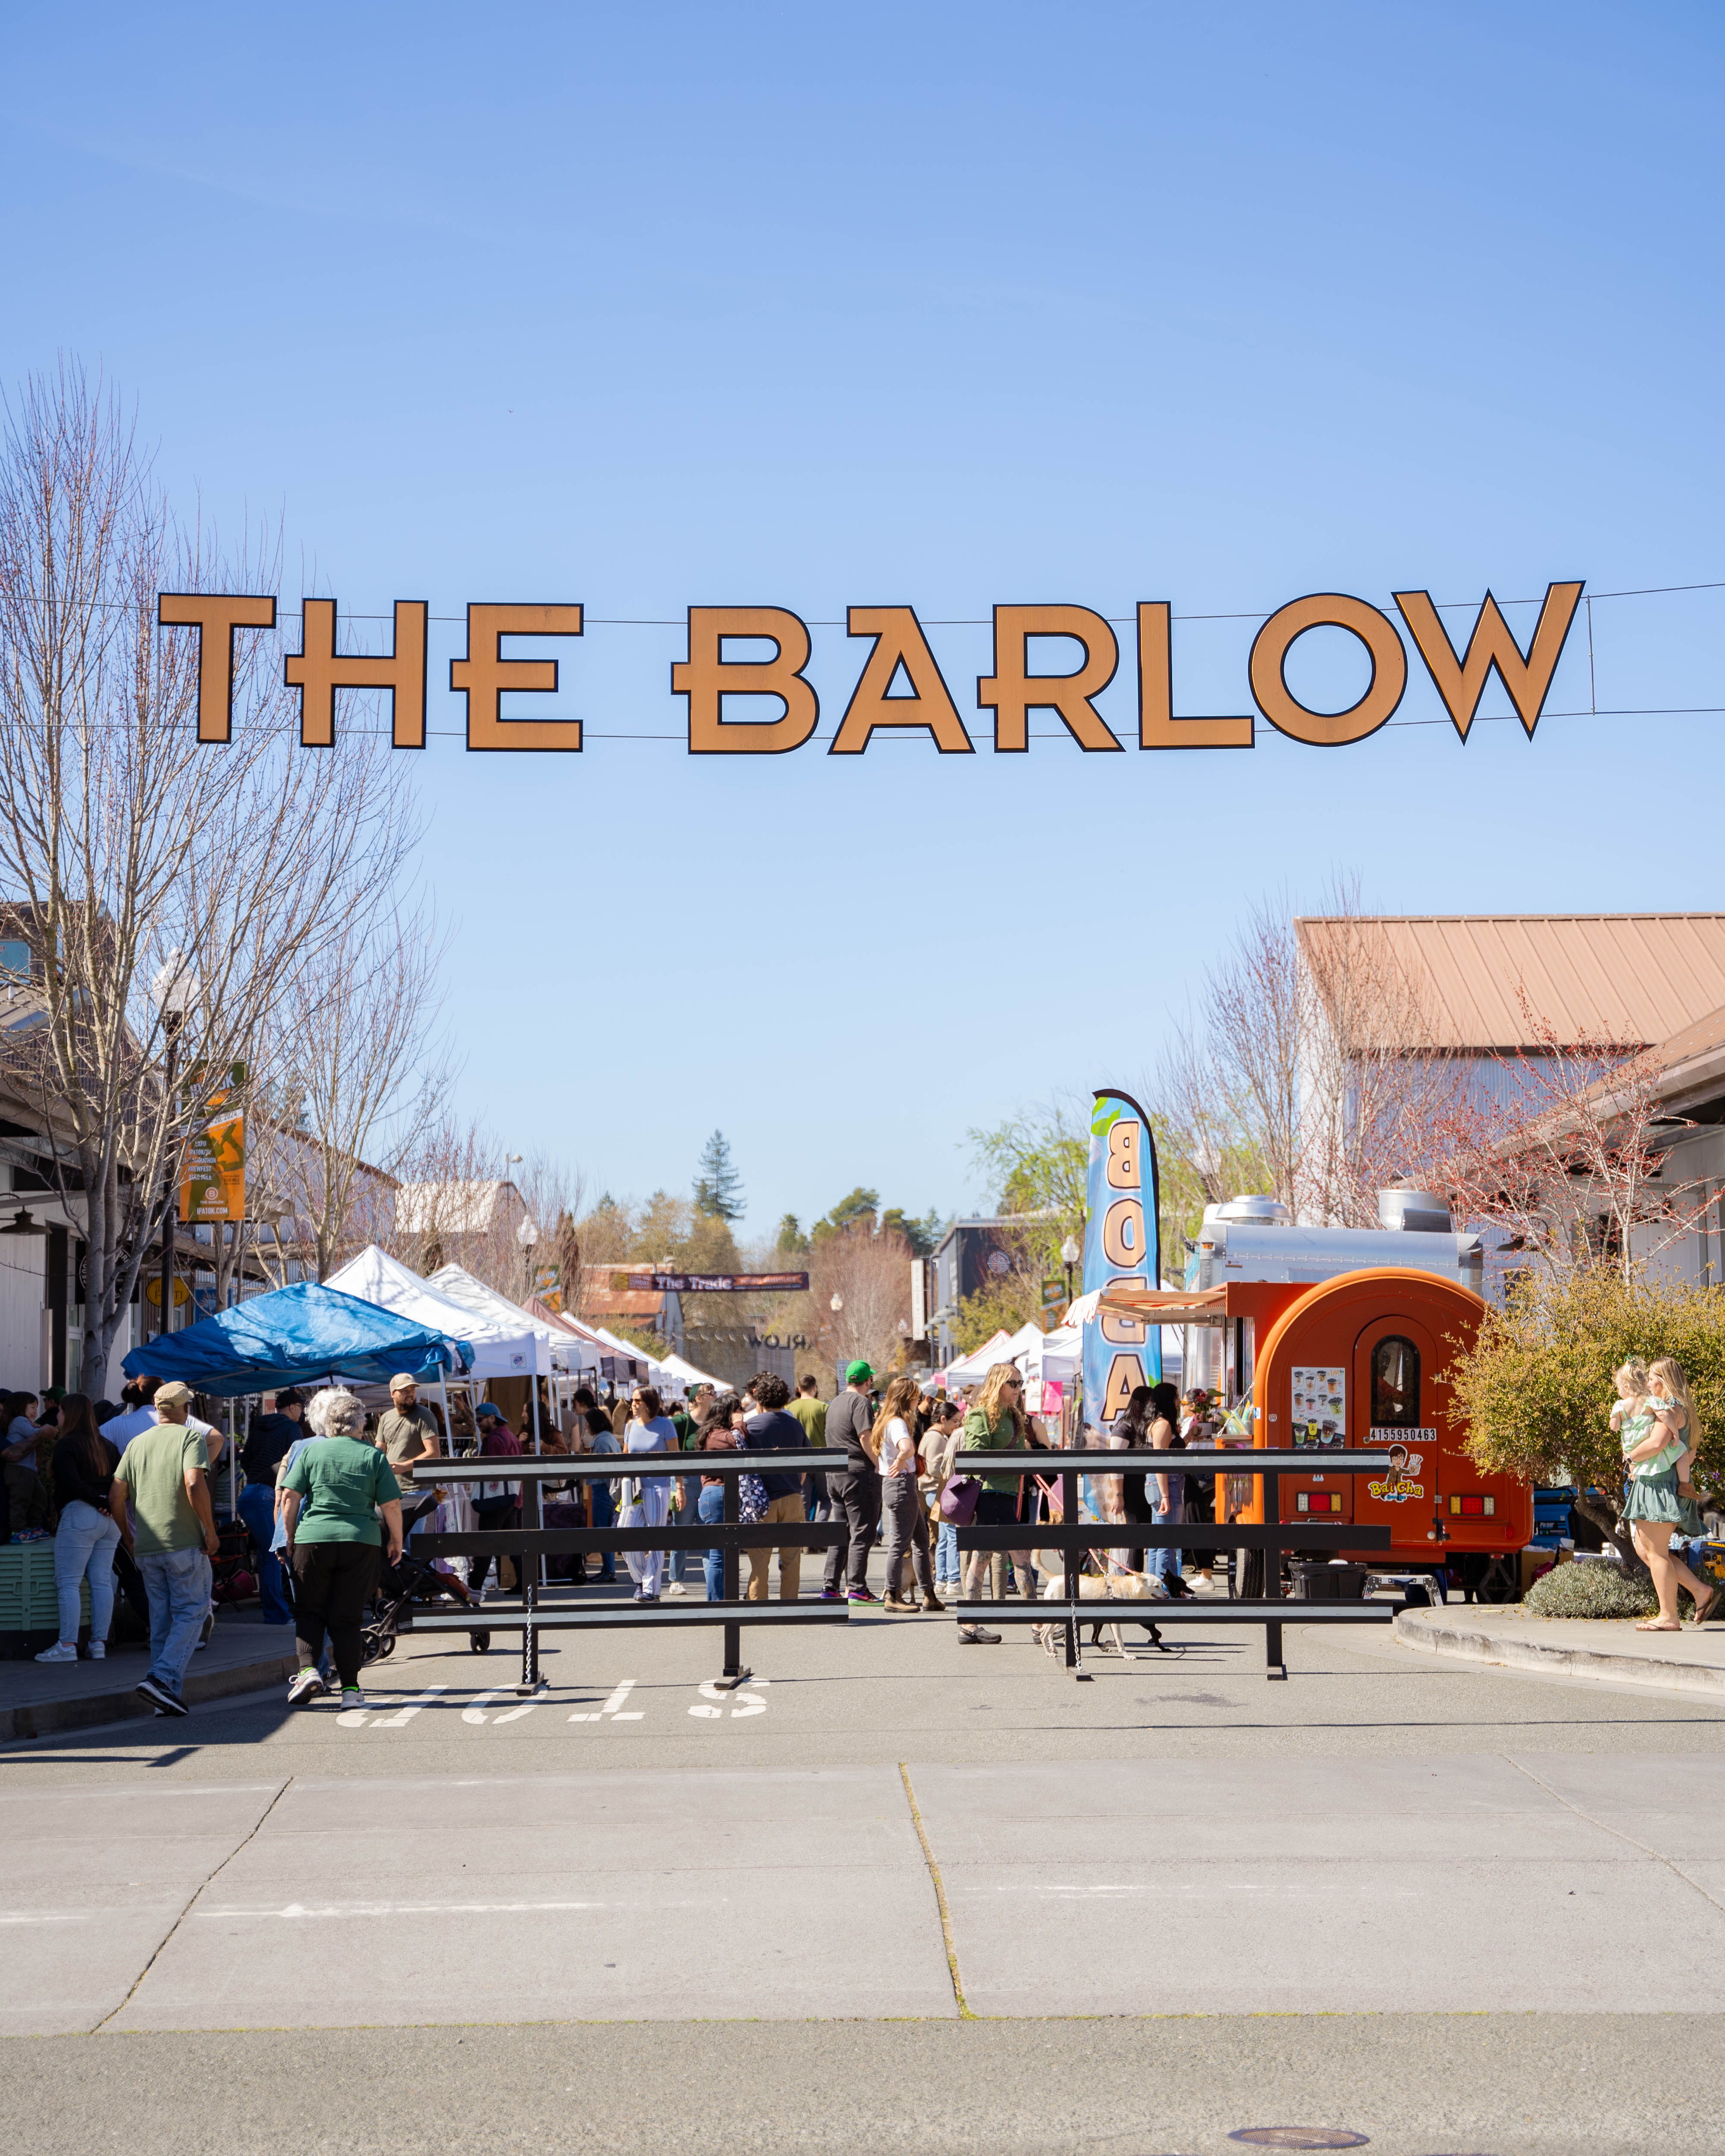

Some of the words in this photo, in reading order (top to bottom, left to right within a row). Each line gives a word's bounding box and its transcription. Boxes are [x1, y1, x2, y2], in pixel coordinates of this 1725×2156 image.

[158, 592, 583, 752] THE
[671, 580, 1587, 755] BARLOW
[224, 1111, 237, 1120] 2024
[655, 1275, 685, 1289] The
[688, 1276, 732, 1290] Trade
[1371, 1429, 1435, 1440] 4155950463
[1370, 1482, 1394, 1495] Bai
[1397, 1482, 1422, 1495] Cha
